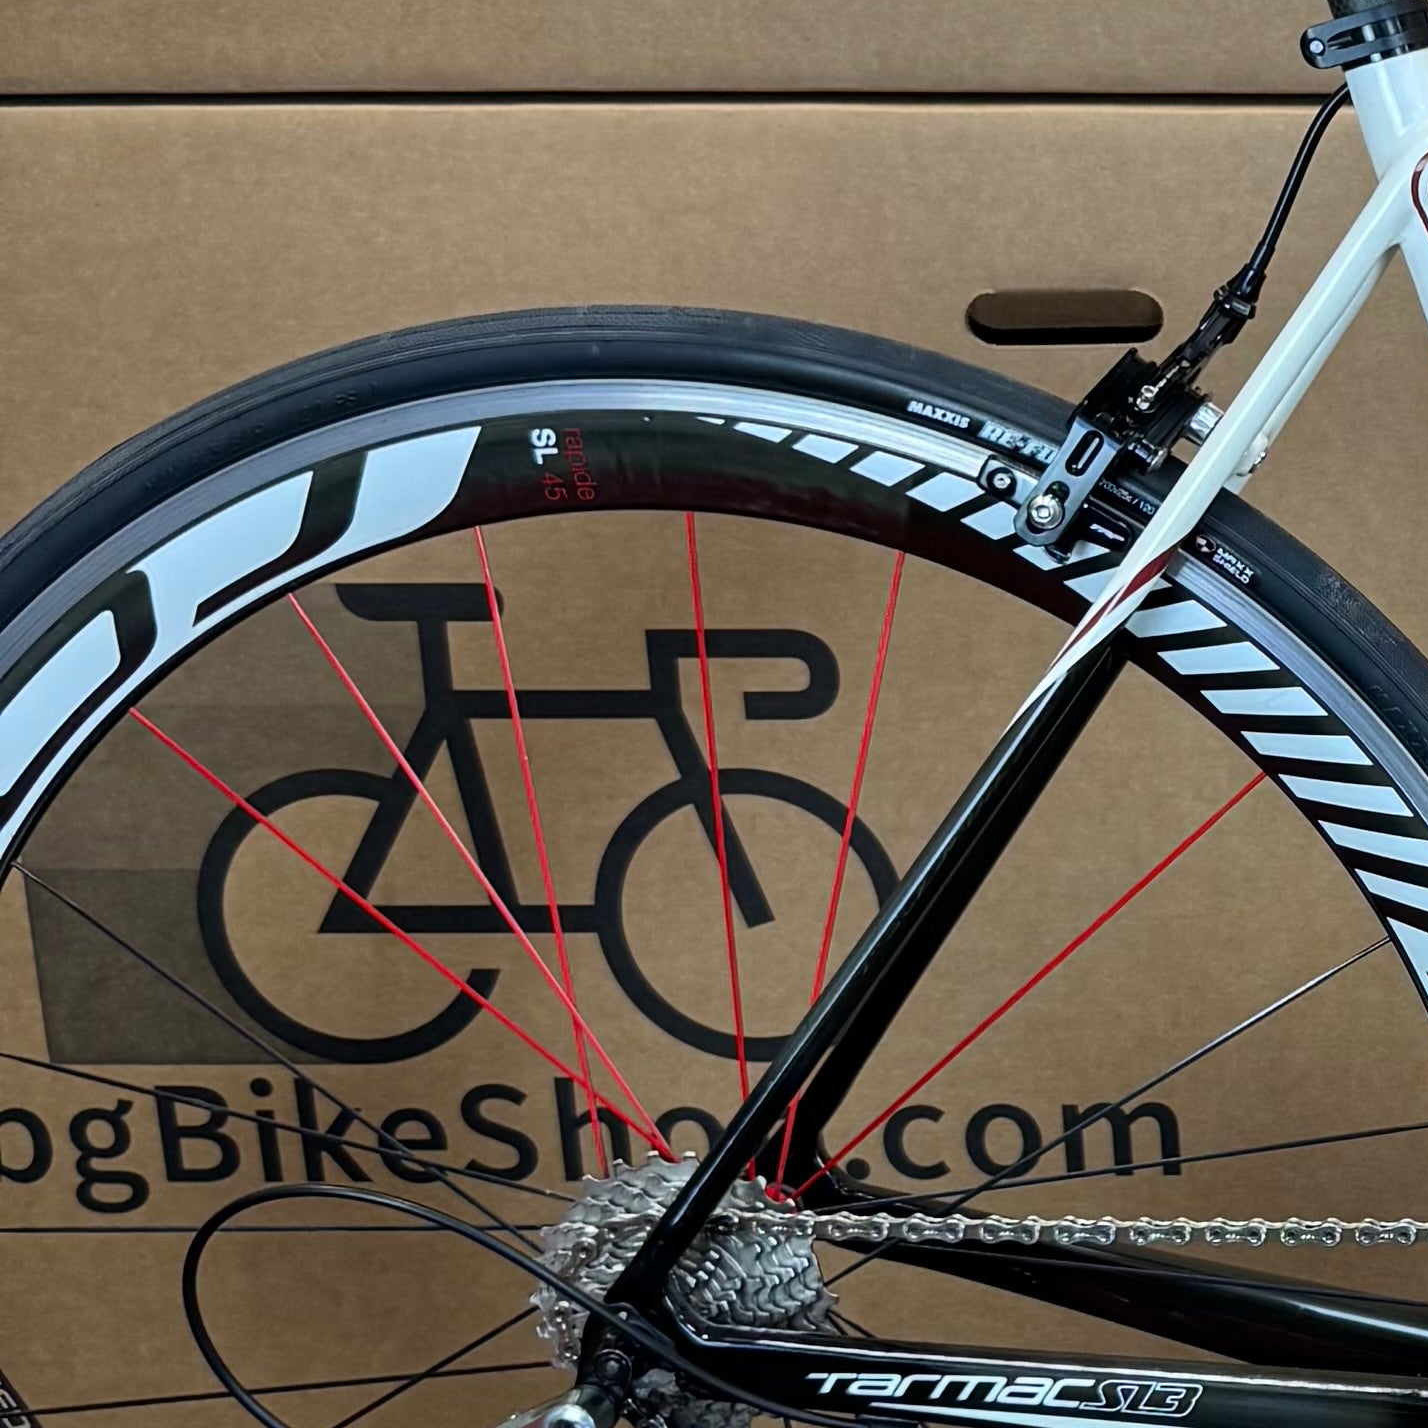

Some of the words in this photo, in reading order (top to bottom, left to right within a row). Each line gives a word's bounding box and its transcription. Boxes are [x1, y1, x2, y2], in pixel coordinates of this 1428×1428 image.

[908, 400, 971, 429] MAXXIS
[531, 428, 559, 465] SL
[0, 1075, 1182, 1212] gBikeSho.com
